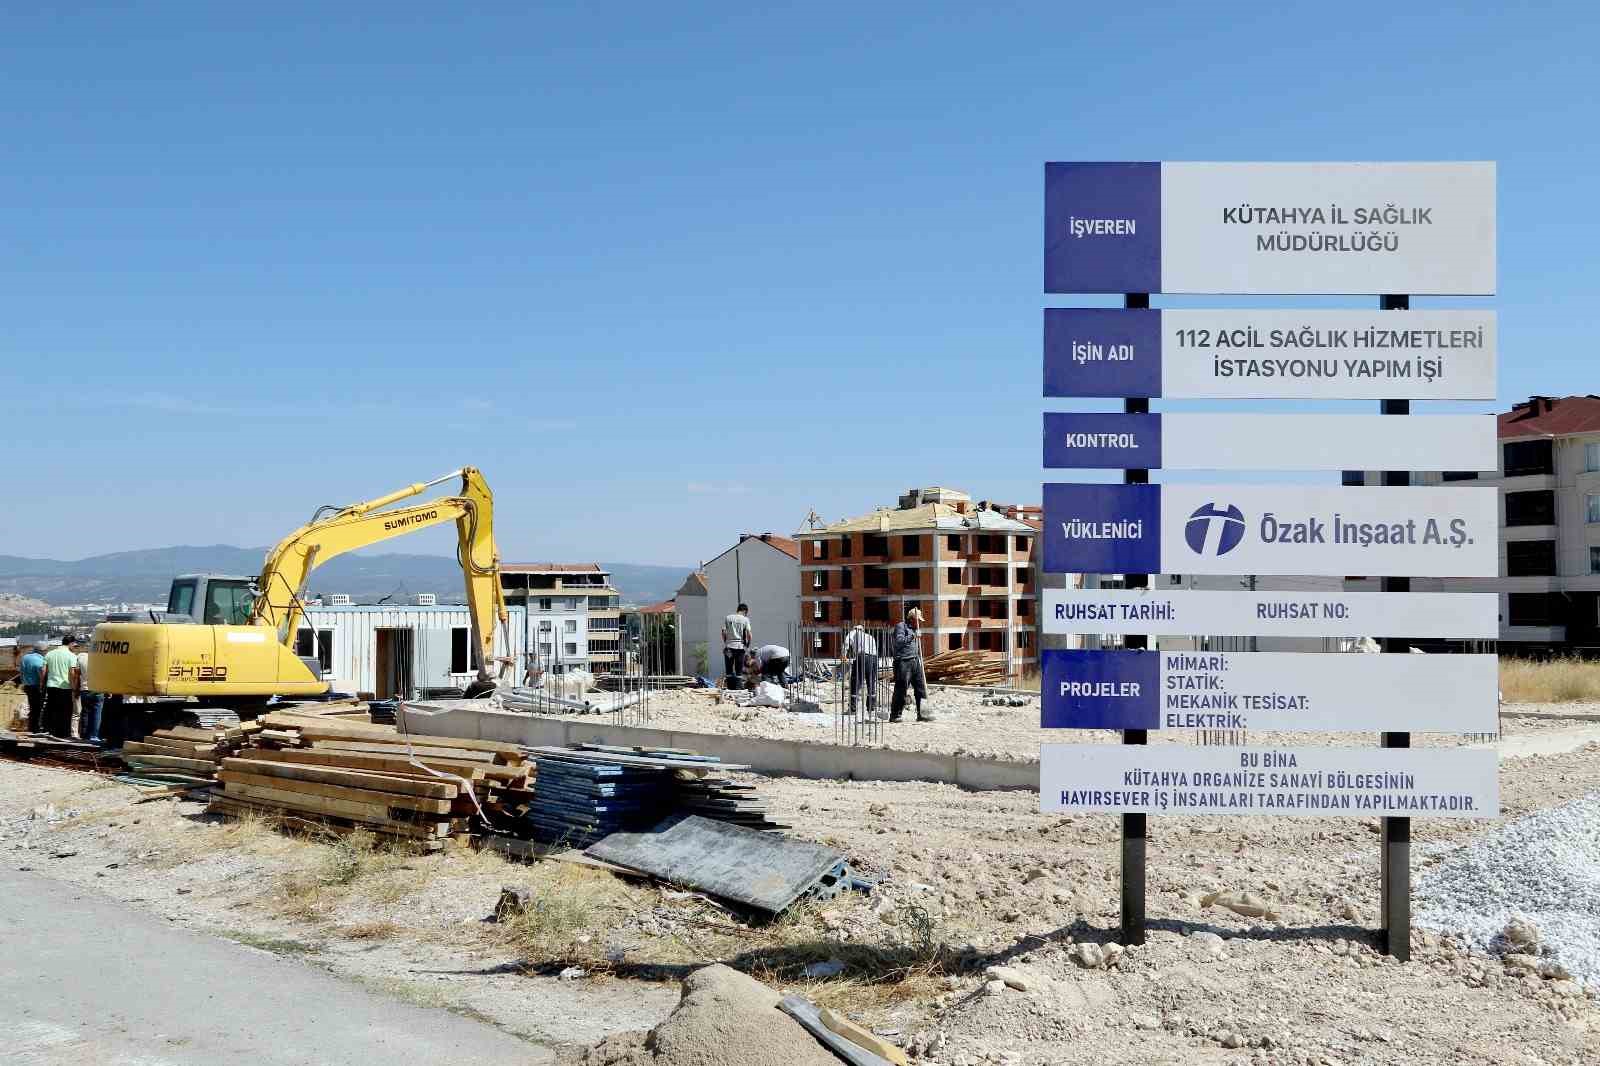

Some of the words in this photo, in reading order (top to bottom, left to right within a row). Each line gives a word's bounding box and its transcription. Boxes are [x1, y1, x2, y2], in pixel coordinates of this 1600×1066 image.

[1223, 203, 1326, 225] KÜTAHYA
[1331, 203, 1350, 225] İL
[1353, 203, 1433, 225] SAĞLIK
[1070, 215, 1136, 239] İŞVEREN
[1256, 230, 1400, 252] MÜDÜRLÜĞÜ
[1175, 329, 1211, 348] 112
[1215, 325, 1265, 348] ACİL
[1269, 325, 1348, 349] SAĞLIK
[1353, 325, 1484, 349] HİZMETLERİ
[1071, 340, 1103, 365] İŞİN
[1107, 344, 1134, 361] ADI
[1213, 354, 1338, 378] İSTASYONU
[1343, 359, 1412, 378] YAPIM
[1416, 355, 1443, 383] İŞİ
[1065, 433, 1140, 449] KONTROL
[384, 510, 438, 530] SUMITOMO
[1061, 518, 1143, 539] YÜKLENİCİ
[1260, 512, 1326, 545] Özak
[1333, 513, 1417, 548] İnşaat
[1422, 518, 1475, 549] A.Ş.
[1055, 603, 1117, 621] RUHSAT
[1120, 600, 1176, 621] TARİHİ:
[1256, 602, 1319, 619] RUHSAT
[1323, 602, 1349, 620] NO:
[1166, 653, 1229, 672] MİMARİ:
[1060, 681, 1141, 697] PROJELER
[1166, 674, 1224, 691] STATİK:
[1166, 693, 1238, 710] MEKANİK
[1242, 693, 1310, 711] TESİSAT:
[1166, 712, 1247, 729] ELEKTRİK:
[1240, 752, 1259, 768] BU
[1263, 749, 1298, 768] BİNA
[1124, 768, 1189, 787] KÜTAHYA
[1192, 769, 1266, 788] ORGANİZE
[1269, 770, 1323, 789] SANAYİ
[1326, 770, 1415, 790] BÖLGESİNİN
[1060, 790, 1150, 806] HAYIRSEVER
[1153, 788, 1169, 810] İŞ
[1172, 788, 1254, 808] İNSANLARI
[1256, 792, 1351, 809] TARAFINDAN
[1354, 794, 1480, 811] YAPILMAKTADIR.
